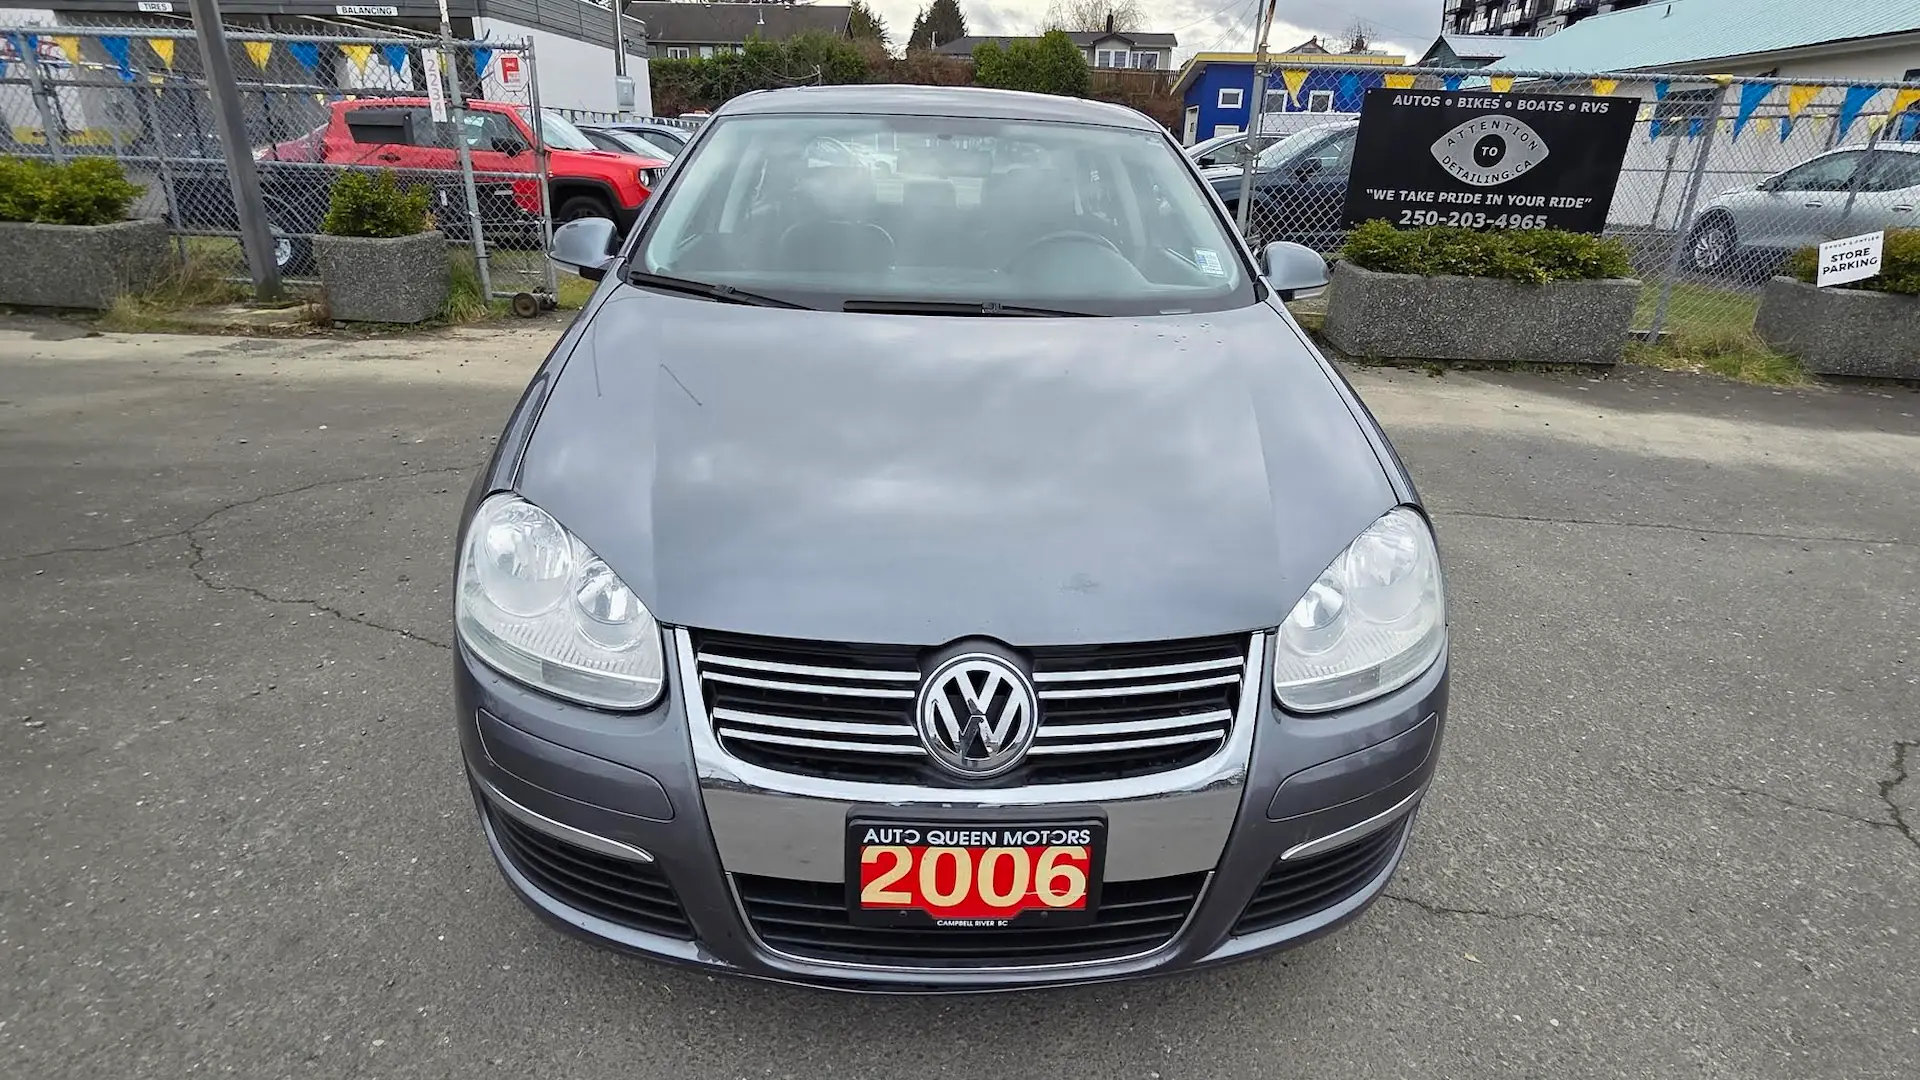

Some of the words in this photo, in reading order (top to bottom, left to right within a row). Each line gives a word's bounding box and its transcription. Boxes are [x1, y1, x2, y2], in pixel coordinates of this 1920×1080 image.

[144, 3, 168, 11] TIRES
[341, 6, 392, 15] BALANCING
[1392, 94, 1441, 107] AUTOS
[1457, 97, 1501, 110] BIKES
[1517, 99, 1564, 112] BOATS
[1580, 101, 1610, 114] RVS
[1446, 120, 1539, 151] ATTENTION
[1481, 146, 1499, 157] TO
[1441, 155, 1533, 184] DETAILING.CA
[1398, 190, 1435, 203] TAKE
[1437, 192, 1483, 205] PRIDE
[1485, 193, 1504, 206] IN
[1506, 195, 1546, 208] YOUR
[1398, 209, 1548, 230] 250-203-4965
[1830, 247, 1871, 263] STORE
[1822, 256, 1879, 275] PARKING
[926, 830, 997, 846] QUEEN
[1003, 829, 1091, 846] MOTORS
[860, 845, 1088, 908] 2006
[936, 919, 974, 927] CAMPBELL
